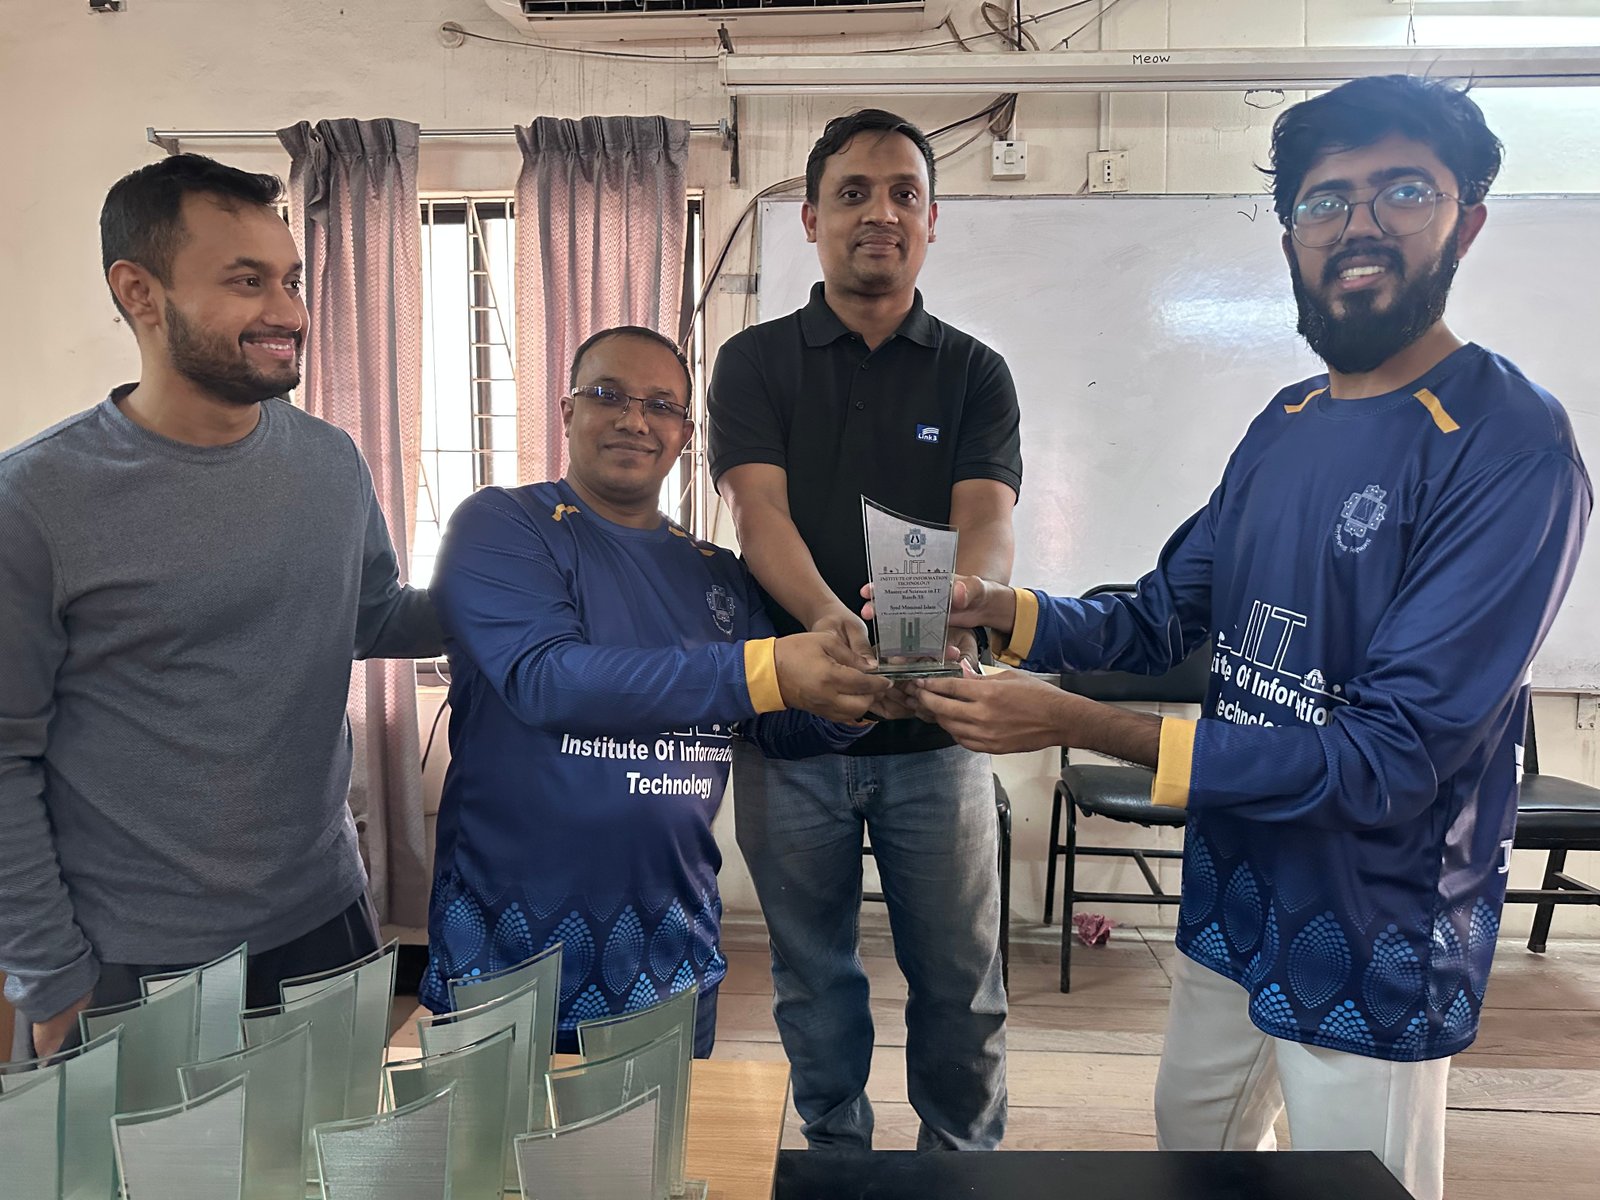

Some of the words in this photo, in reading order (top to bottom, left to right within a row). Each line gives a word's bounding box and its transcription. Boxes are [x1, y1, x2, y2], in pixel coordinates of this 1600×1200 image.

[1132, 54, 1171, 65] Meow
[1236, 664, 1252, 690] Of
[560, 733, 649, 761] Institute
[654, 739, 675, 762] Of
[626, 771, 712, 800] Technology
